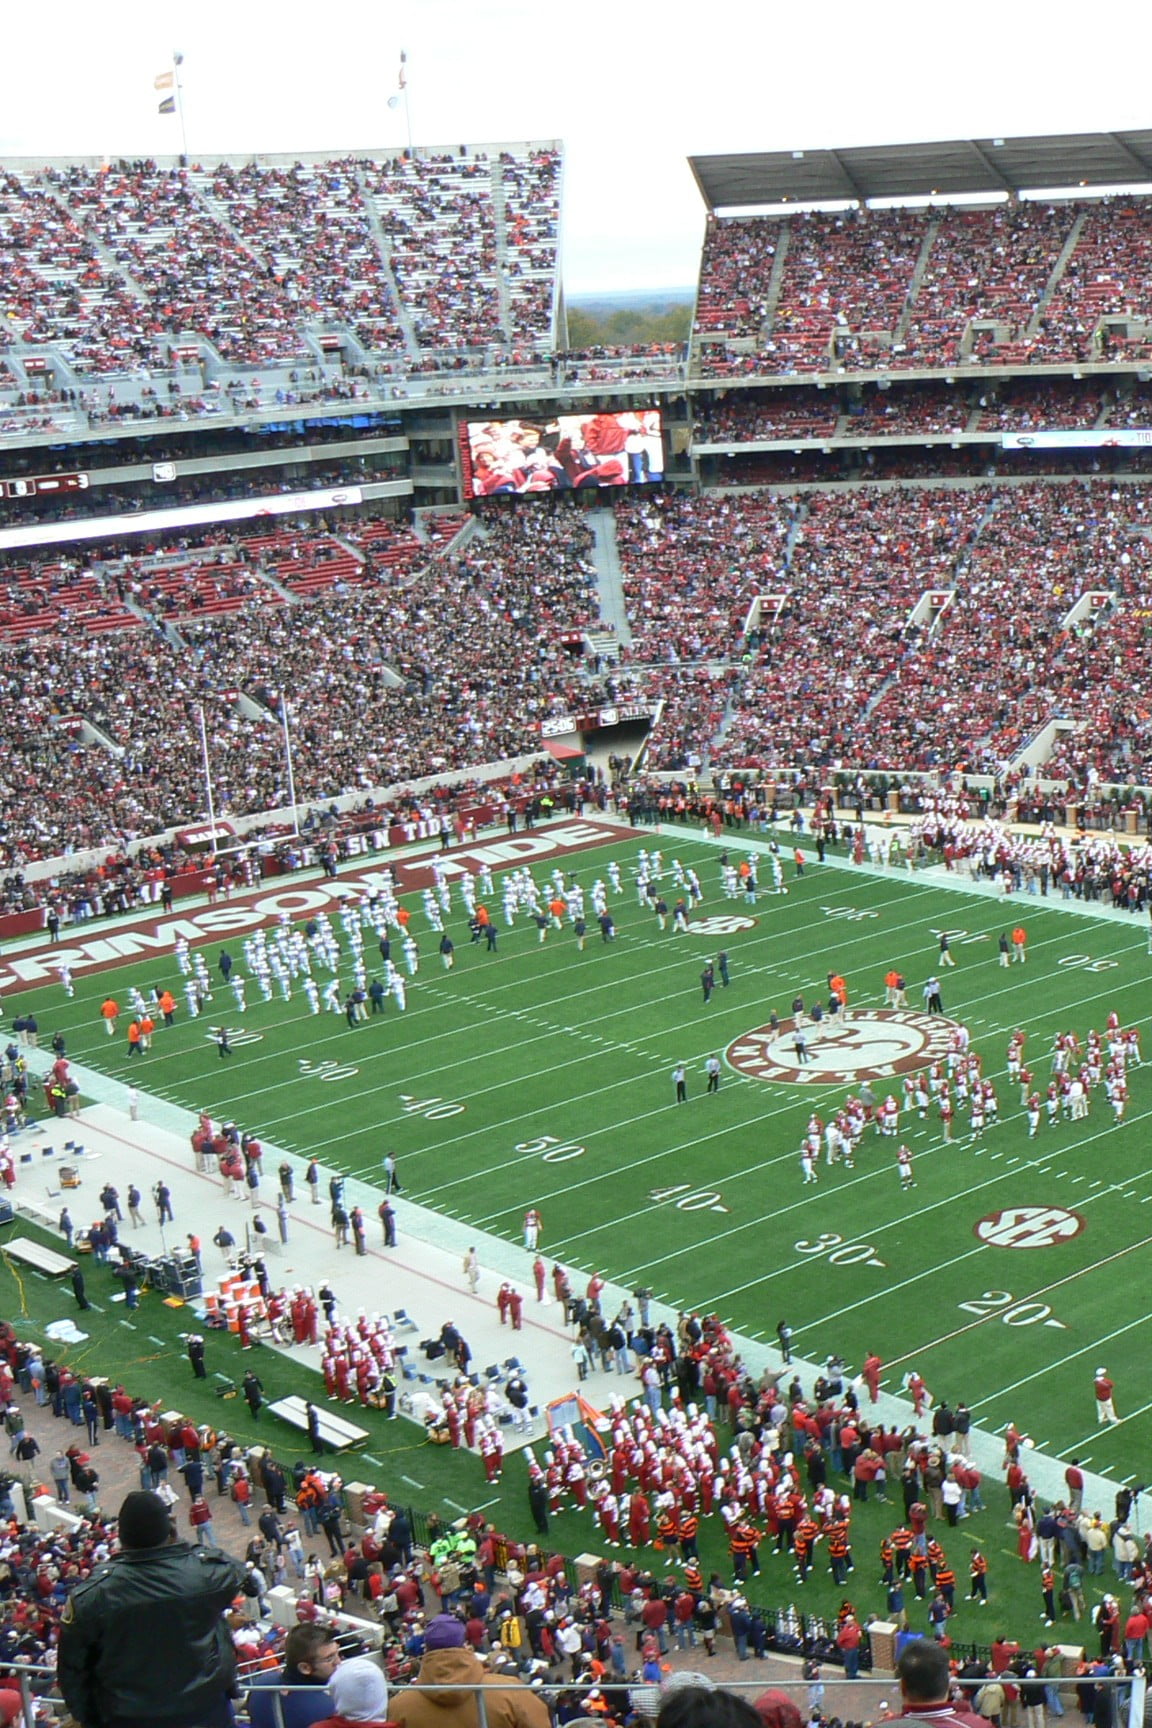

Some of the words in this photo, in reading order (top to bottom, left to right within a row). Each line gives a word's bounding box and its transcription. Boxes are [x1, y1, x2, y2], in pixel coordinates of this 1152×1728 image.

[404, 824, 617, 875] TIDE
[1058, 954, 1118, 972] 50
[299, 1060, 360, 1081] 30
[514, 1136, 586, 1162] 50
[648, 1184, 723, 1211] 40
[977, 1206, 1081, 1248] SEC
[794, 1233, 876, 1266] 30
[957, 1289, 1053, 1327] 20
